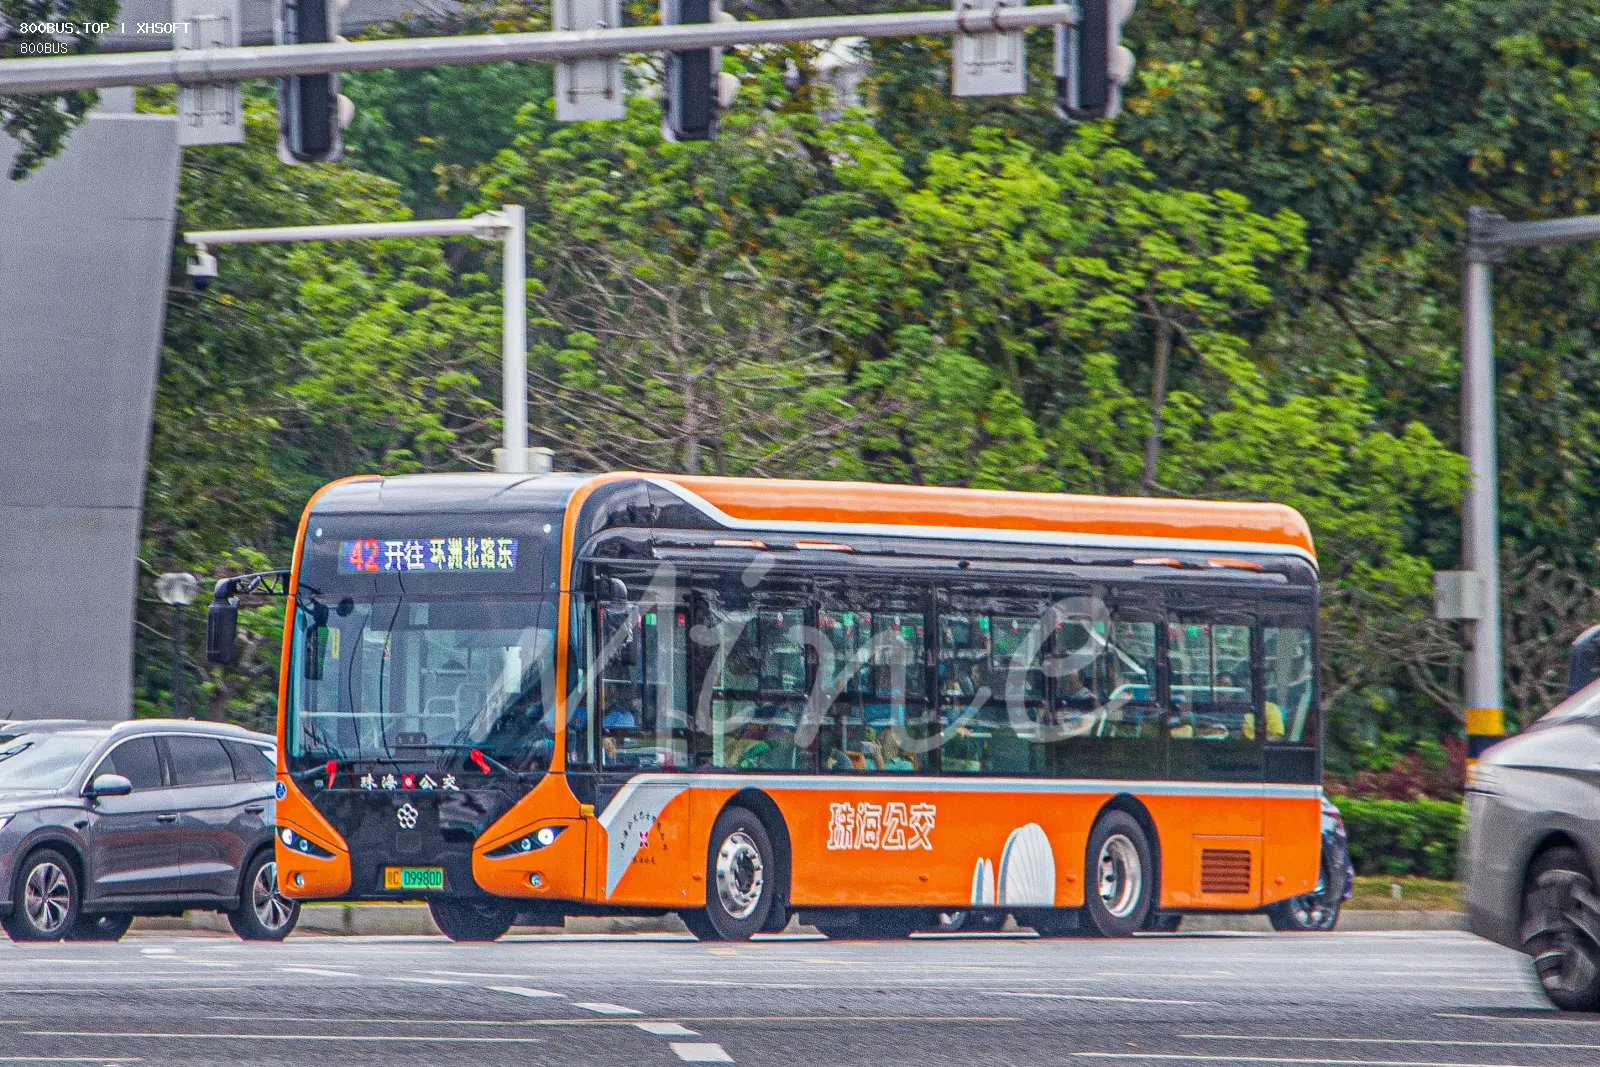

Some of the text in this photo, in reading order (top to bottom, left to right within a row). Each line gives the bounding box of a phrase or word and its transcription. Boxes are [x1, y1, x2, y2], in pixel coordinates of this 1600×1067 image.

[350, 537, 380, 572] 42
[384, 540, 425, 571] 开往
[827, 801, 937, 850] 珠海公交
